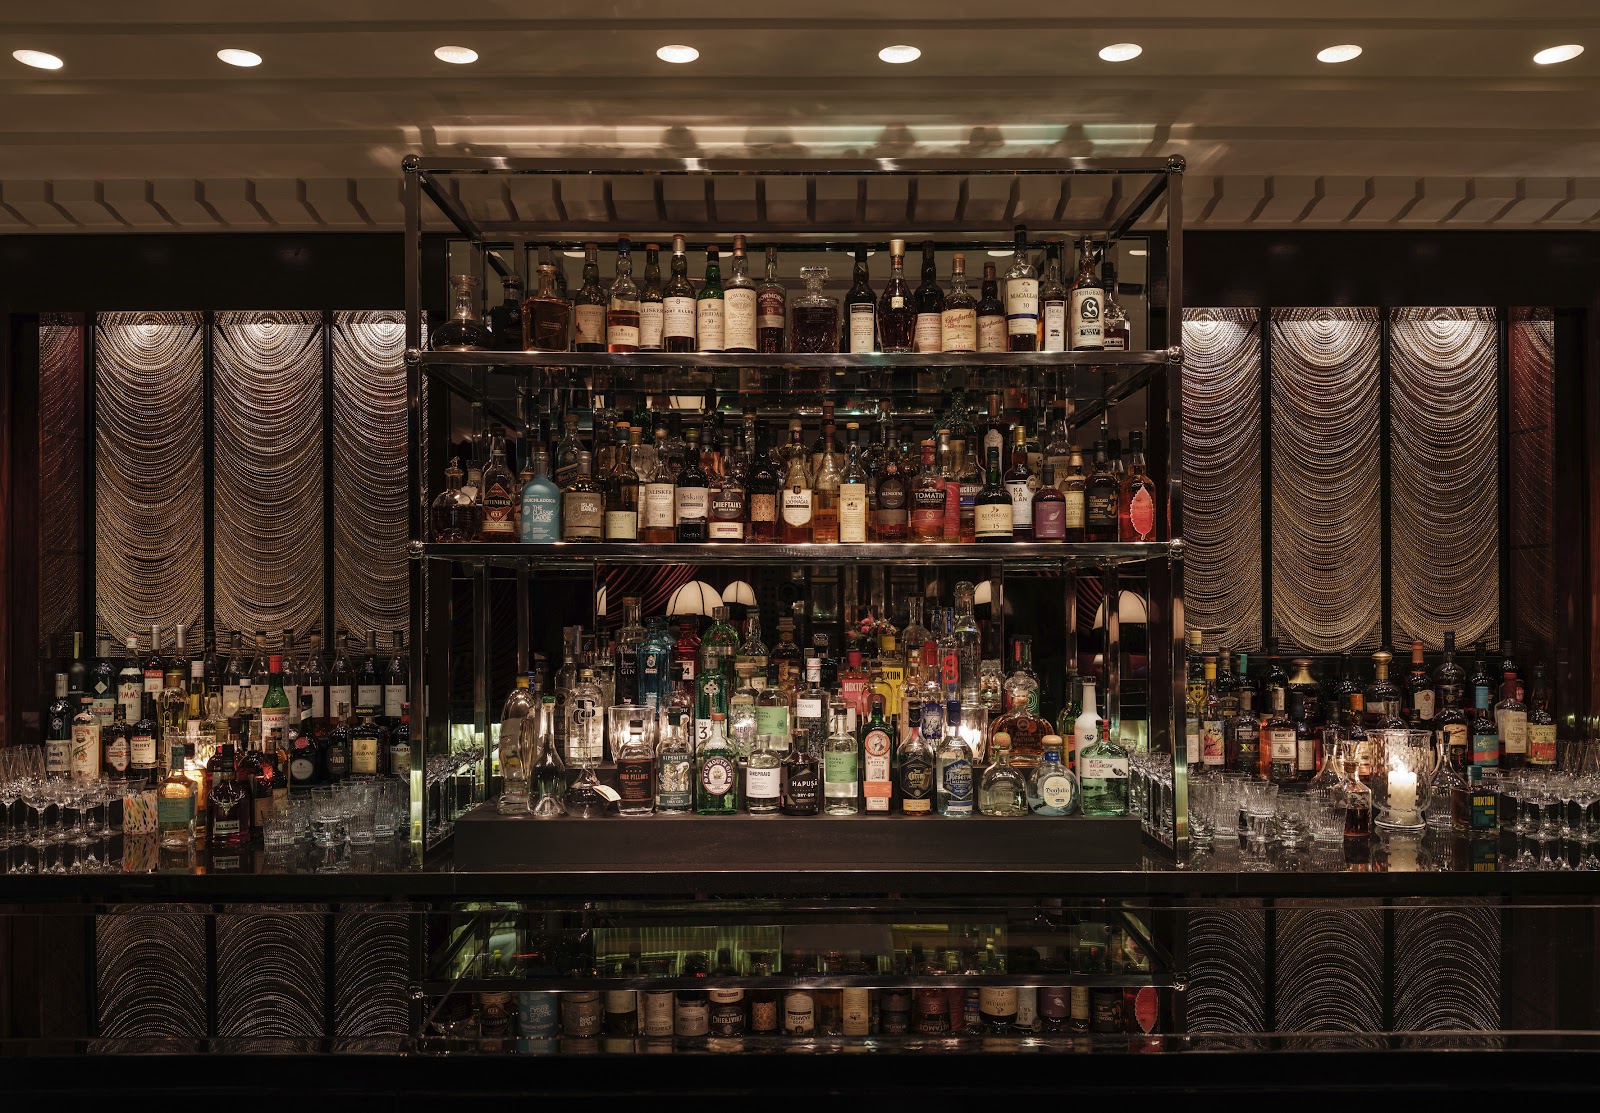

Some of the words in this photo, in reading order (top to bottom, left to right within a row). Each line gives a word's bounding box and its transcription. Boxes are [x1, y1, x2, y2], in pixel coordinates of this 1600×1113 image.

[712, 500, 742, 509] CHIEFTAIN'S
[119, 689, 140, 699] PIMM'S
[698, 726, 708, 740] 3
[332, 756, 345, 764] FAIR
[703, 759, 727, 778] PLYMOUTH
[1473, 796, 1495, 806] HOXTON
